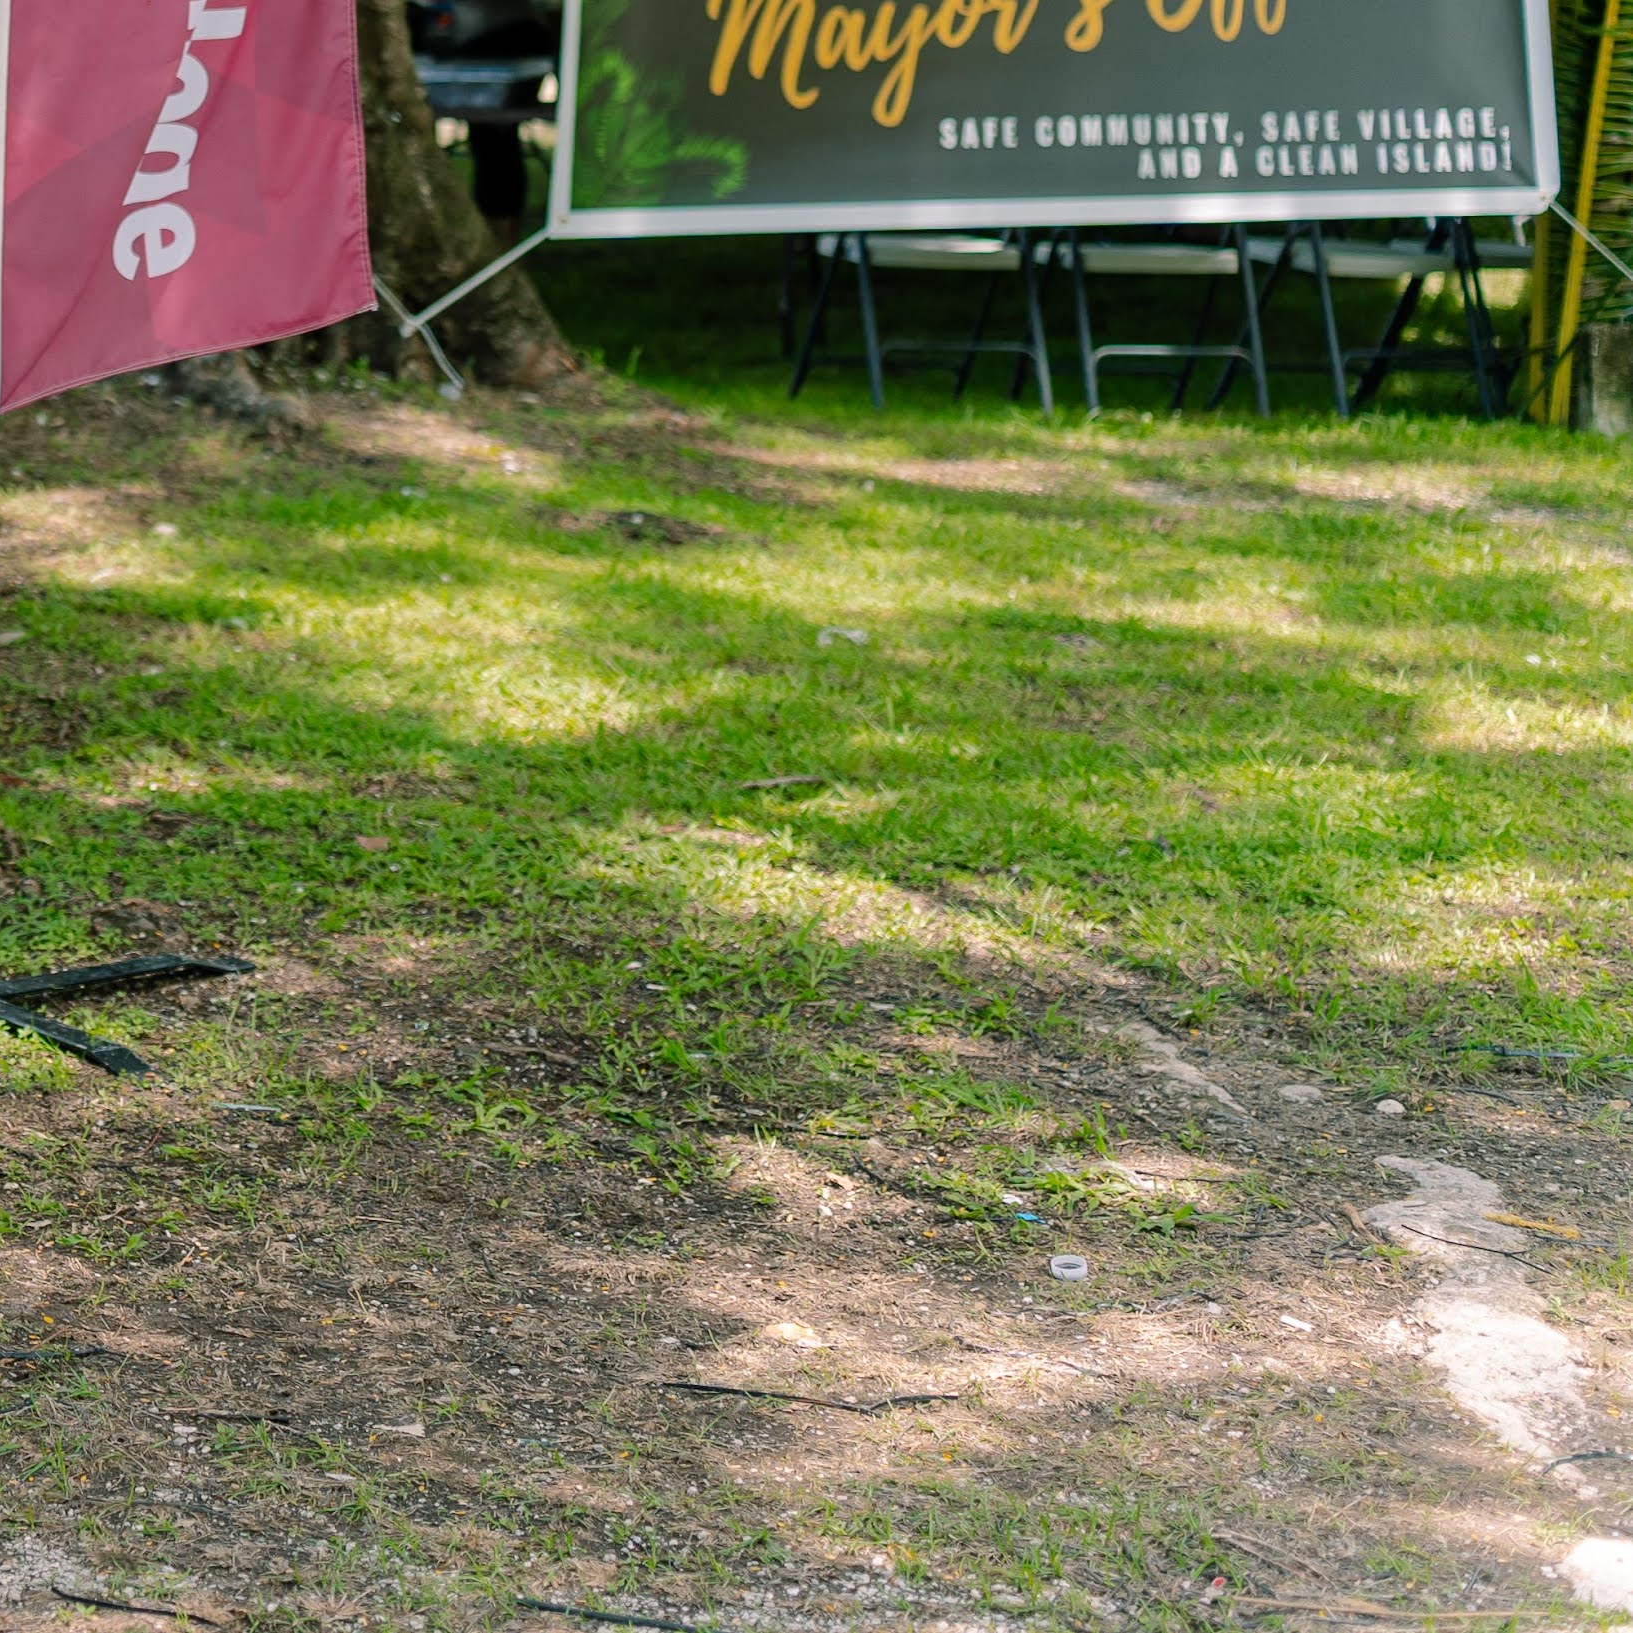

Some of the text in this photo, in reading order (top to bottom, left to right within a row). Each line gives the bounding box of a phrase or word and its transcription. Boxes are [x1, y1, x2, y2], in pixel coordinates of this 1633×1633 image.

[938, 106, 1511, 150] SAFE COMMUNITY, SAFE VILLAGE,
[1137, 139, 1512, 180] AND A CLEAN ISLAND!
